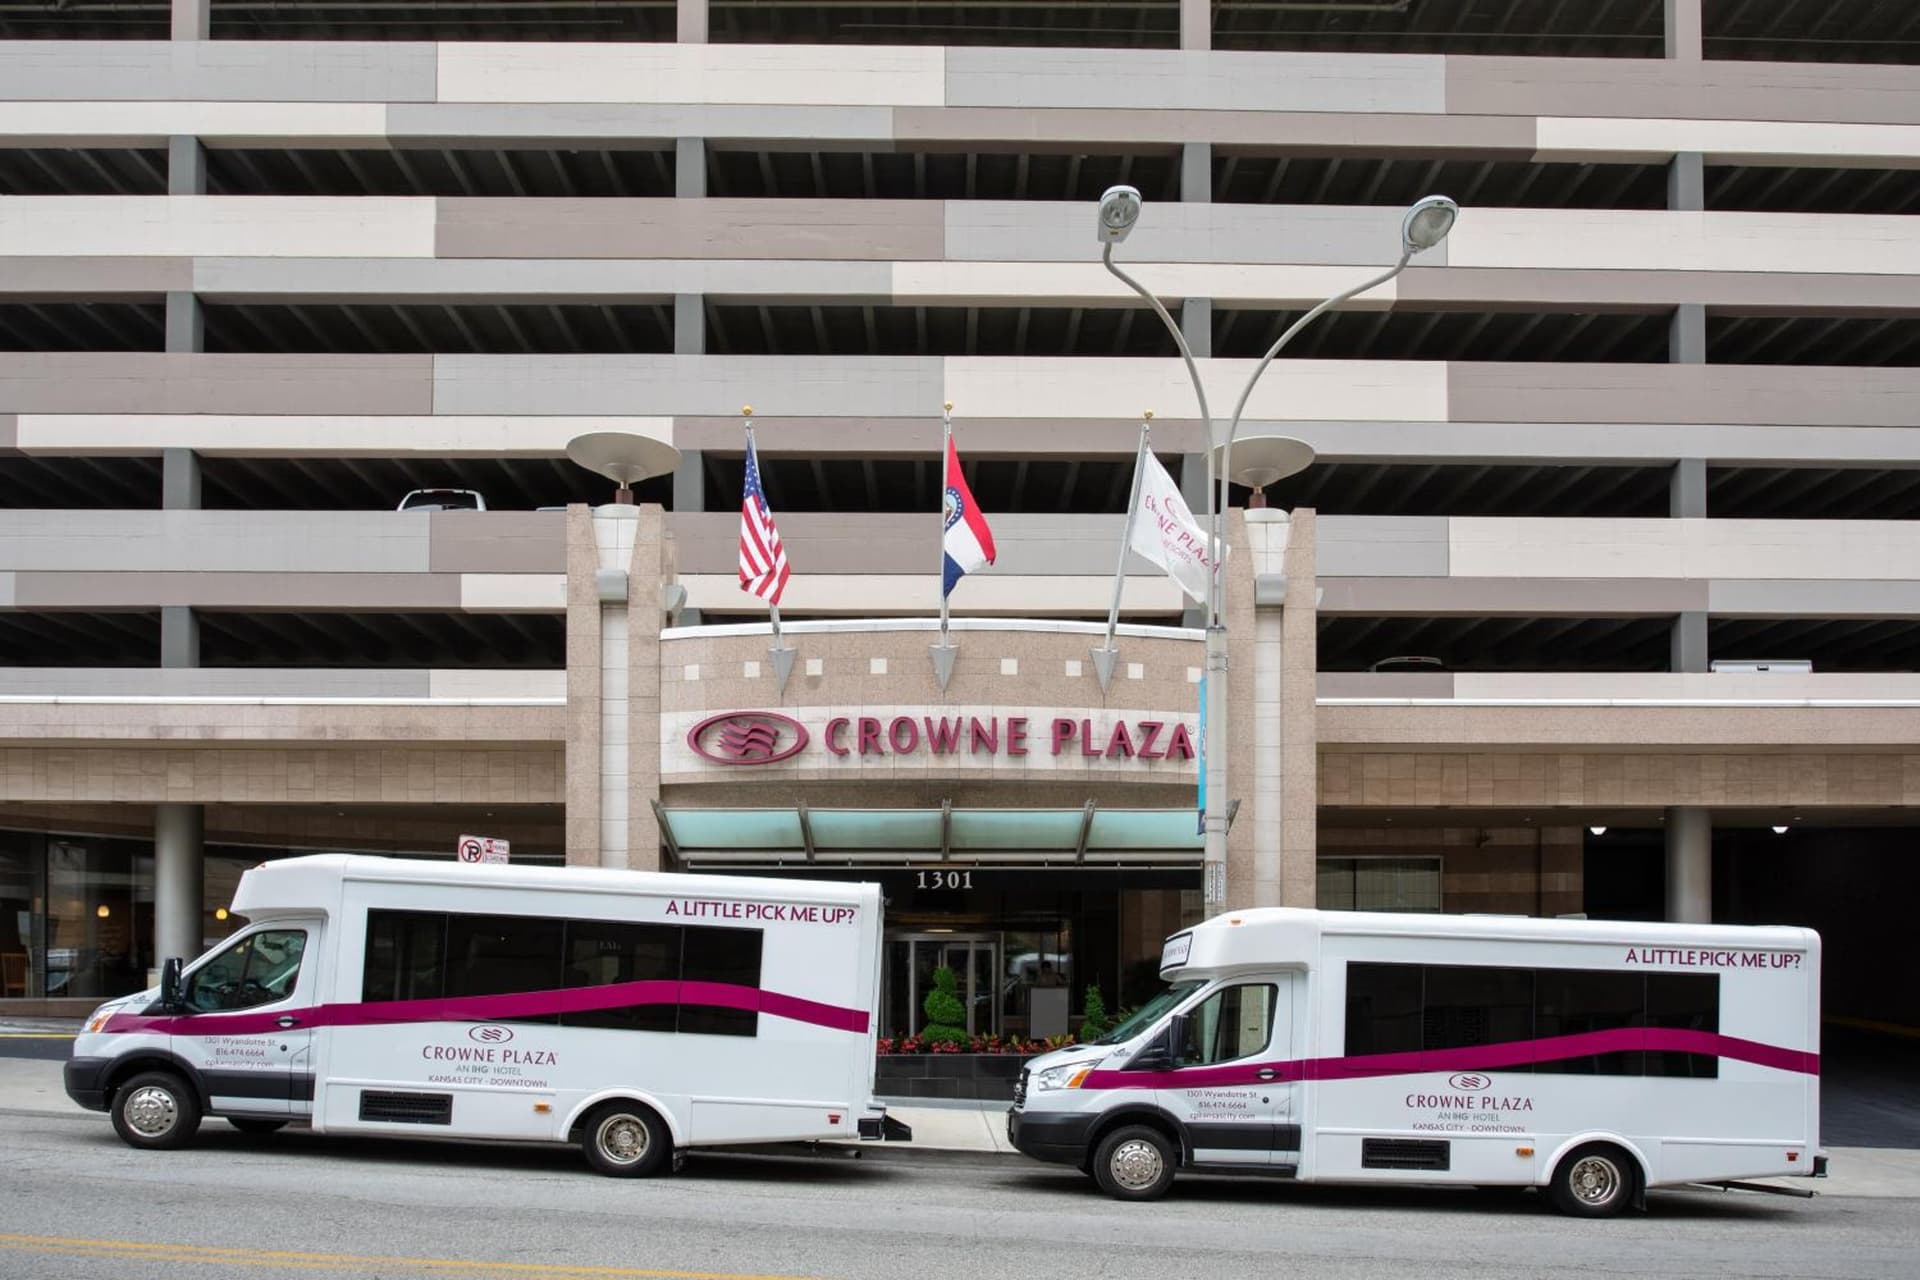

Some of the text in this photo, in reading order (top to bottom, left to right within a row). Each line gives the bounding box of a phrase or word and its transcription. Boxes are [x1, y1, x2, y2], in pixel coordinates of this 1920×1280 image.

[825, 716, 1029, 757] CROWNE
[1051, 718, 1195, 761] PLAZA
[916, 871, 974, 890] 1301
[665, 900, 855, 925] A LITTLE PICK ME UP?
[1625, 949, 1801, 970] A LITTLE PICK ME UP?
[422, 1045, 557, 1066] CROWNE PLAZA
[456, 1065, 523, 1076] AN IHG HOTEL
[428, 1074, 462, 1084] KANSAS
[463, 1076, 484, 1085] CITY
[489, 1077, 548, 1088] DOWNTOWN
[1204, 1090, 1248, 1099] Wyandotte
[1406, 1094, 1534, 1111] CROWNE PLAZA
[1438, 1112, 1500, 1122] AN IHG HOTEL
[1412, 1122, 1445, 1131] KANSAS
[1445, 1123, 1464, 1132] CITY
[1471, 1124, 1527, 1133] DOWNTOWN
